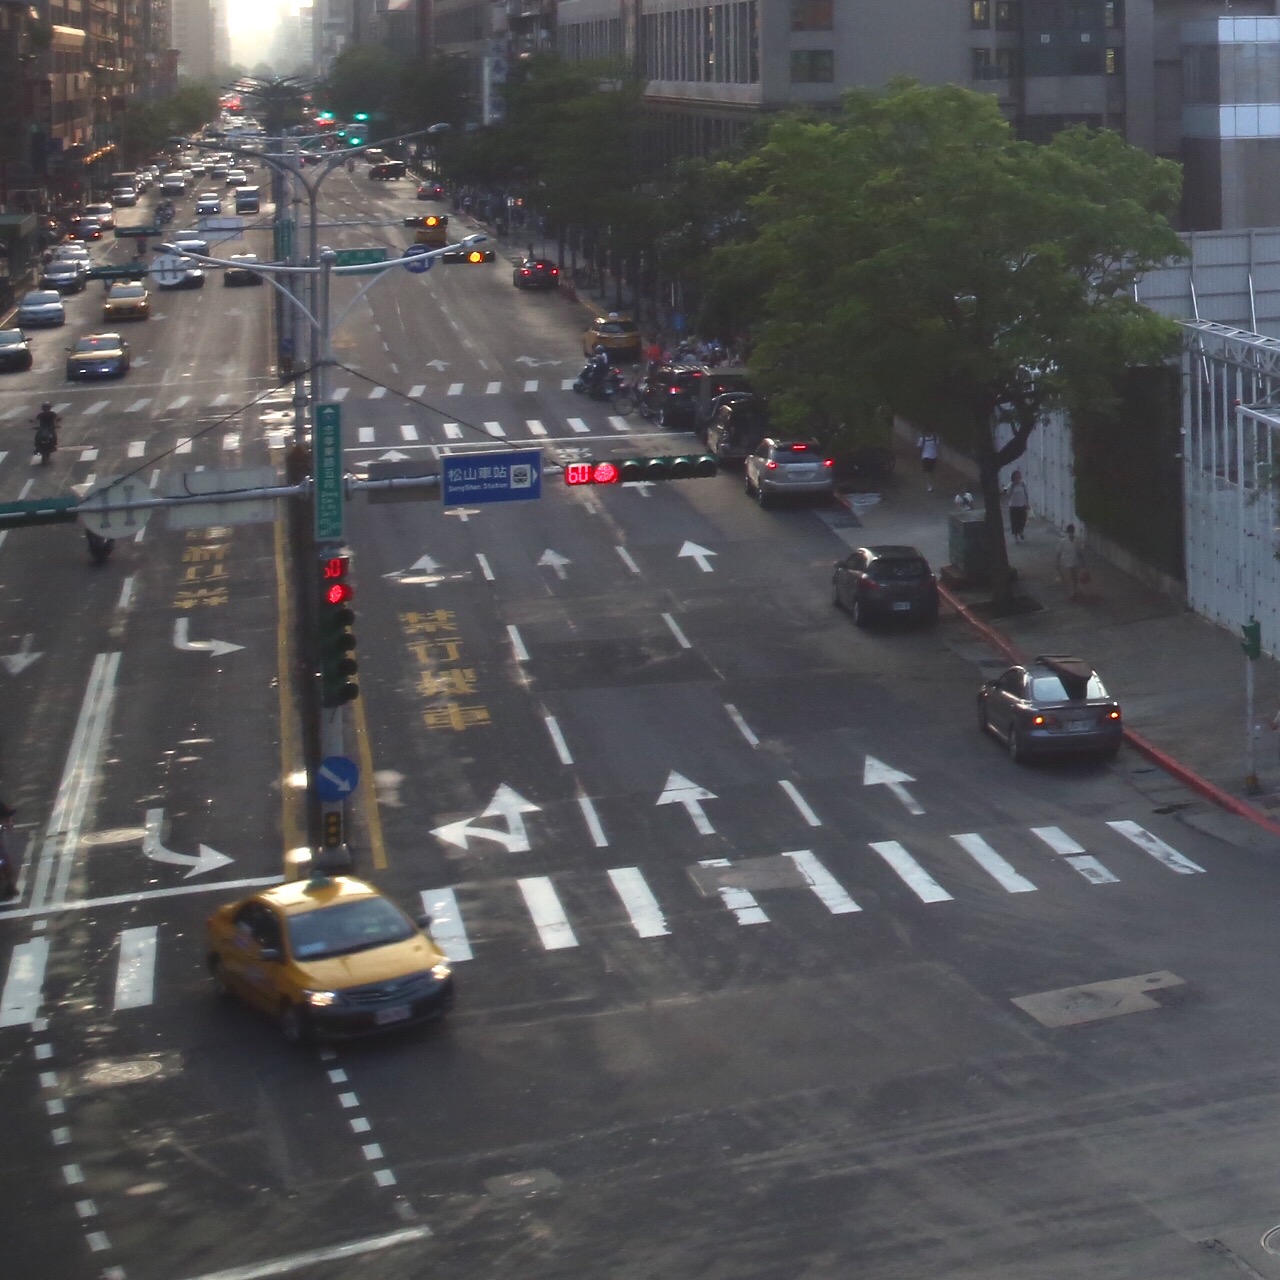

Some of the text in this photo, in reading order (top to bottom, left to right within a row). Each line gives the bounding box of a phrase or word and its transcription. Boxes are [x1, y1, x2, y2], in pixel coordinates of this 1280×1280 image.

[447, 465, 507, 482] 松山車站
[401, 608, 492, 731] 禁行機車
